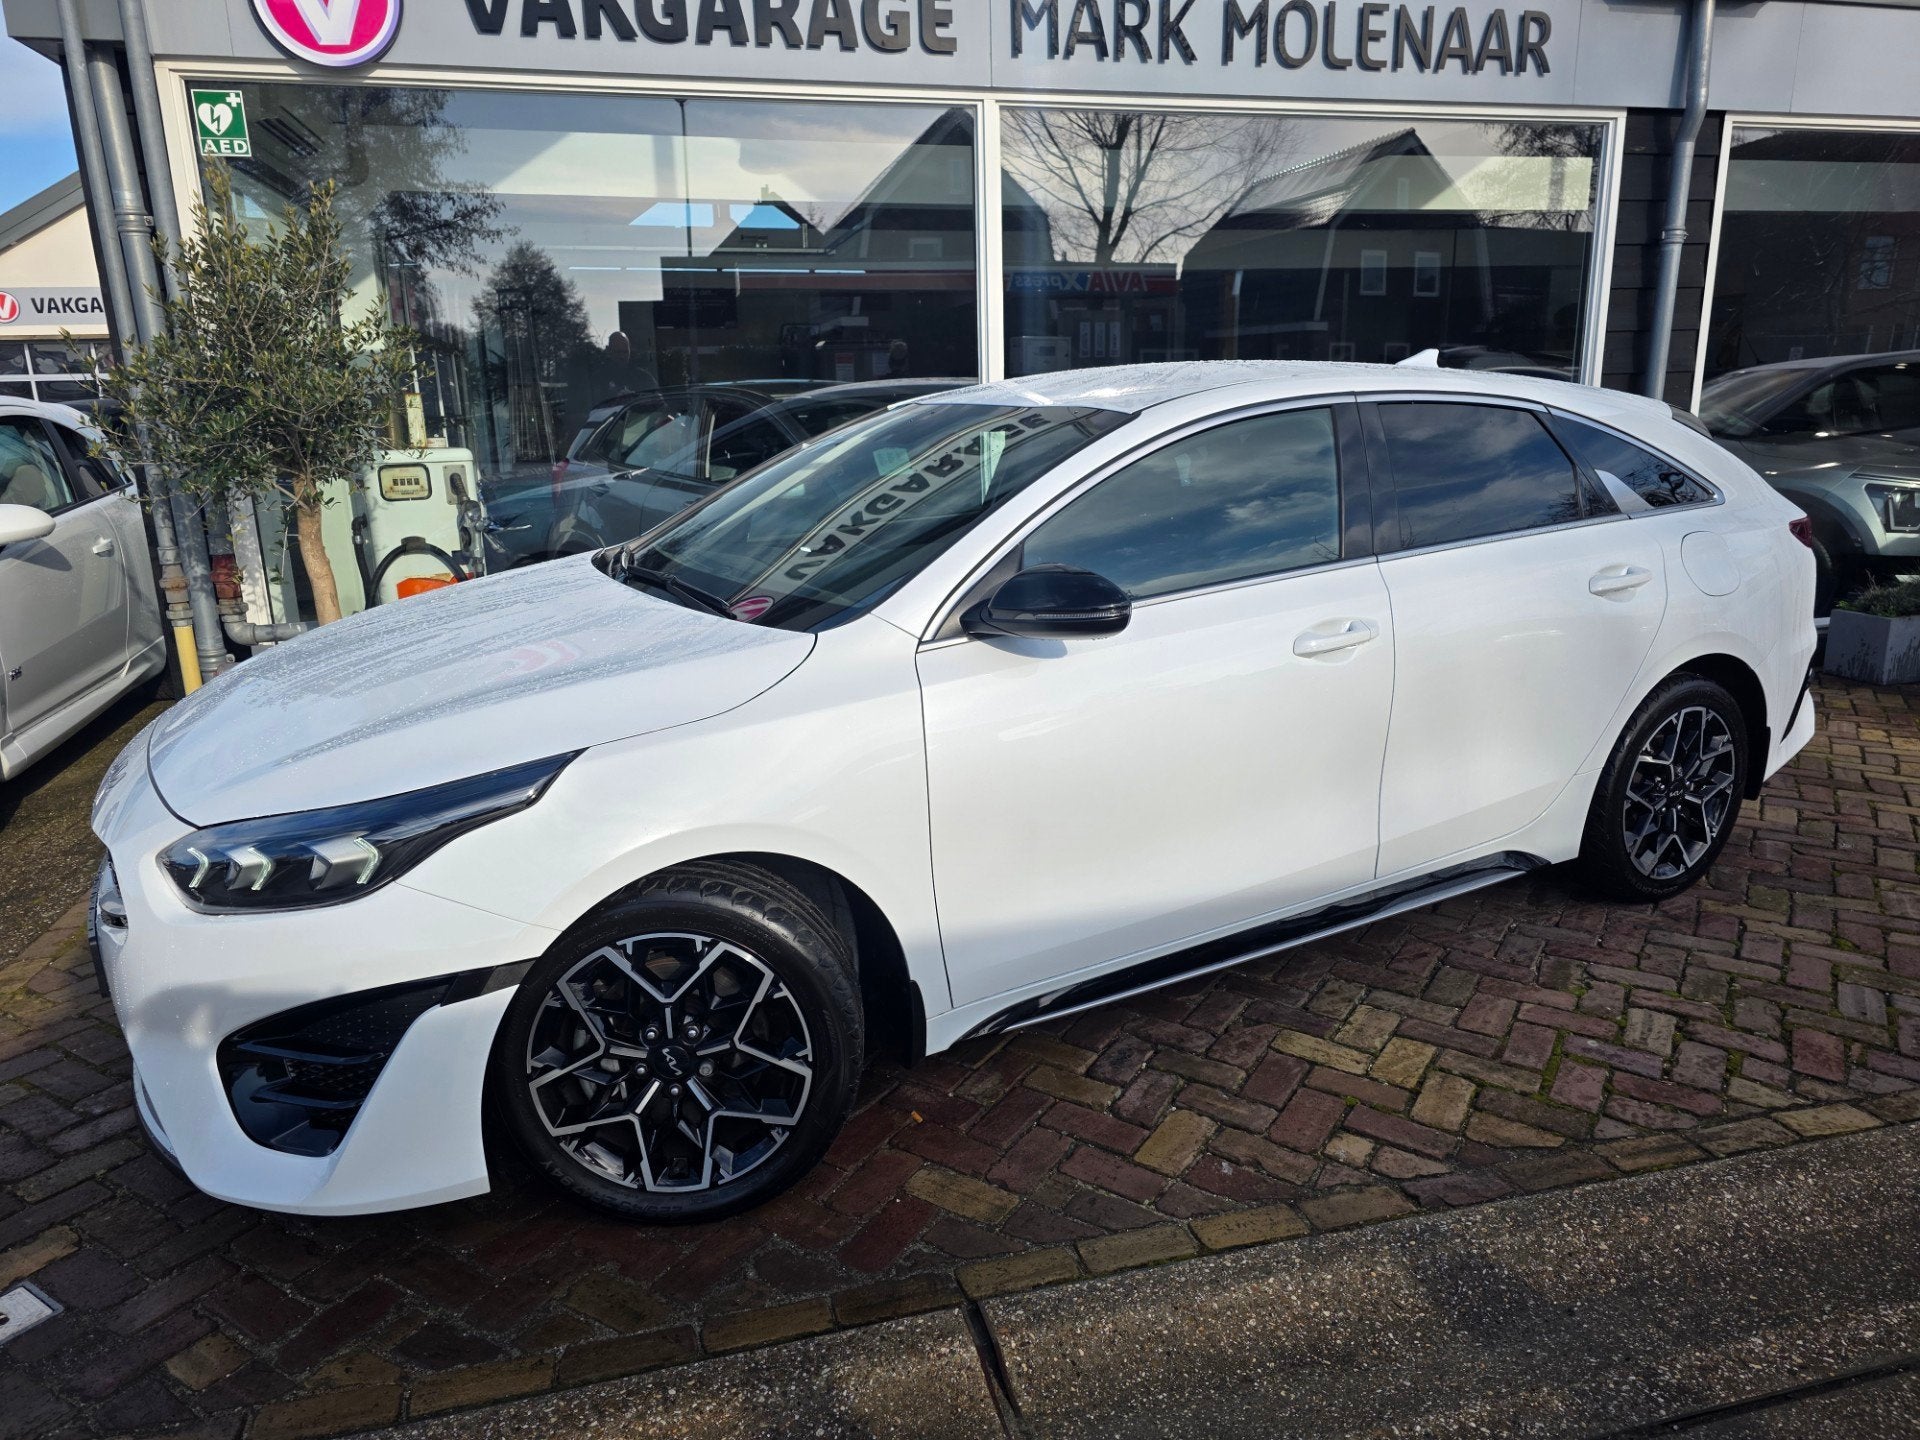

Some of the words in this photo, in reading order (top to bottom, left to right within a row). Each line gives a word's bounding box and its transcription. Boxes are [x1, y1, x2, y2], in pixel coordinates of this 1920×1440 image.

[464, 0, 958, 54] VAKGARAGE
[1009, 0, 1198, 63] MARK
[1221, 0, 1553, 75] MOLENAAR
[203, 139, 248, 154] AED
